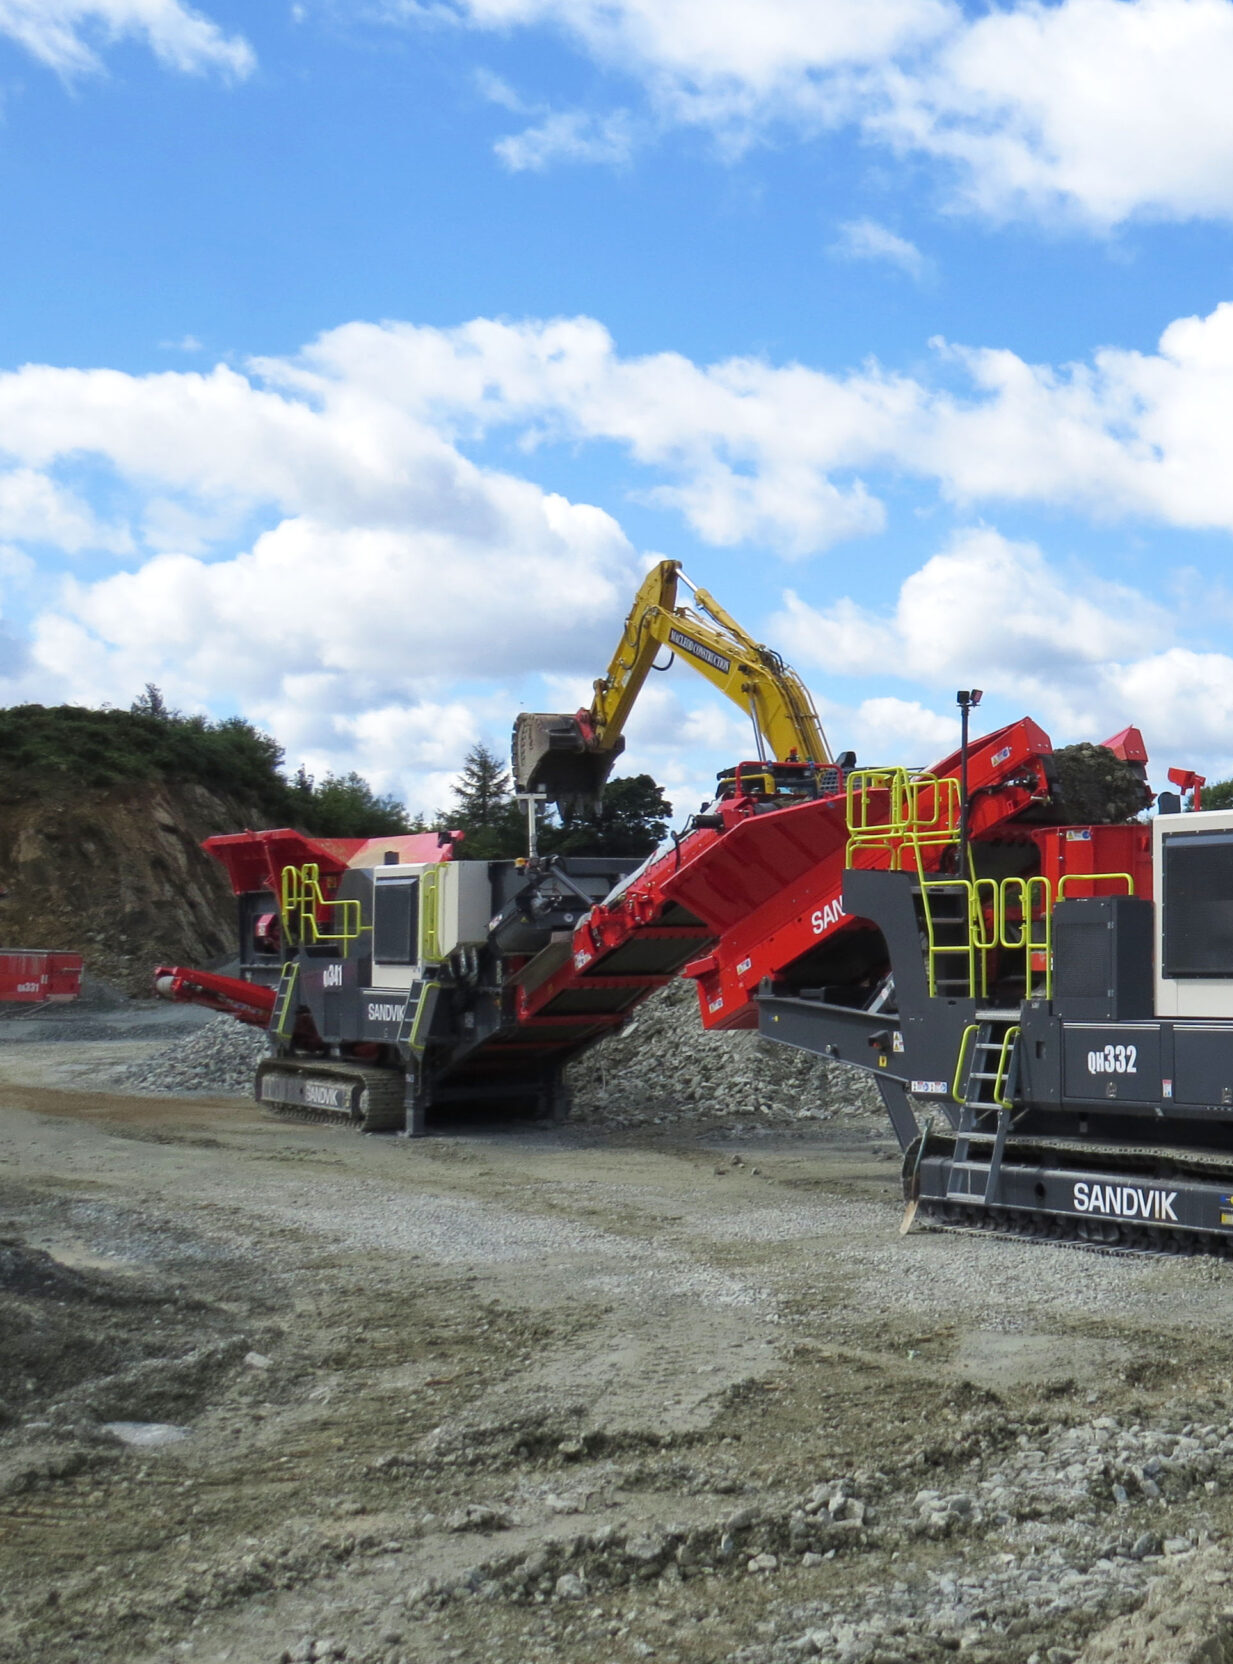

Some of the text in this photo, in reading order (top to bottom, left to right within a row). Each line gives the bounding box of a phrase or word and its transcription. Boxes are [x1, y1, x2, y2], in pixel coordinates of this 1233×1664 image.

[670, 629, 730, 672] MACLEOD CONSTRUCTION
[1087, 1044, 1137, 1074] QH332
[1073, 1182, 1178, 1221] SANDVIK
